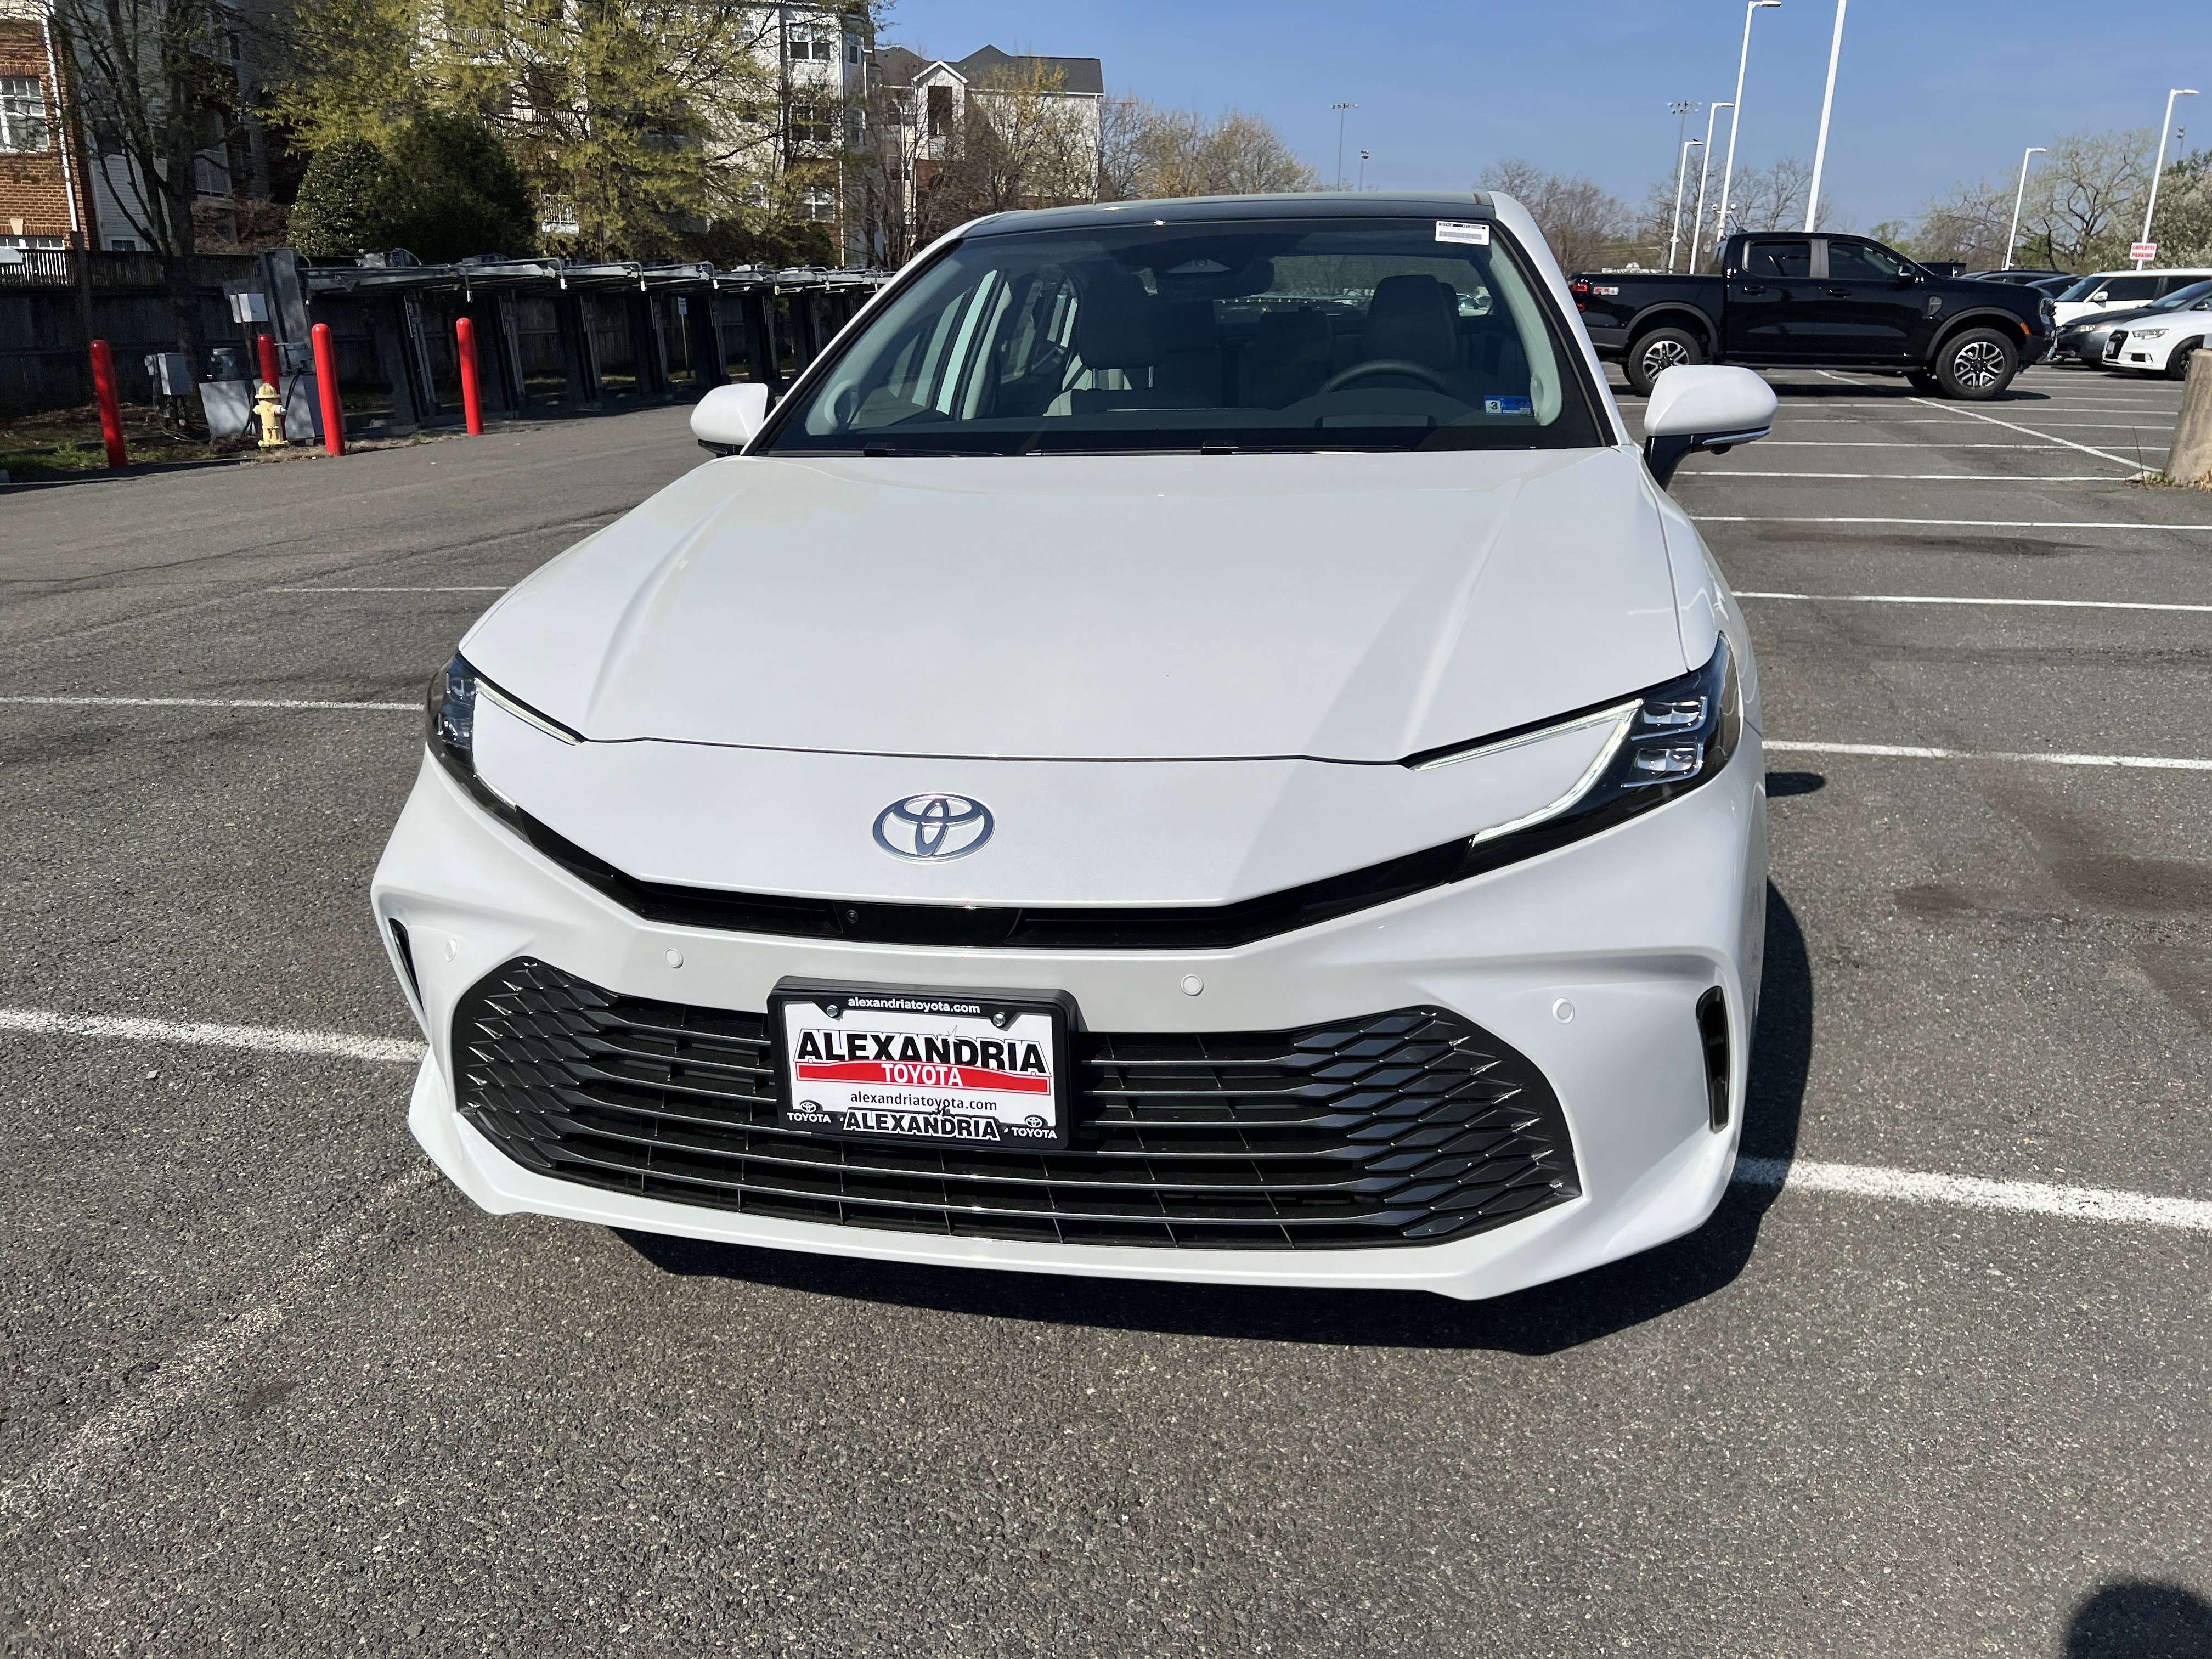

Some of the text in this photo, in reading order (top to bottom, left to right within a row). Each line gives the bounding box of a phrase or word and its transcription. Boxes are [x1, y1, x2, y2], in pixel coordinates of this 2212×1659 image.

[1491, 402, 1498, 410] 3
[848, 996, 980, 1013] alexandriatoyota.com
[796, 1030, 1048, 1074] ALEXANDRIA
[881, 1063, 963, 1086] TOYOTA
[850, 1091, 997, 1111] alexandriatoyota.com
[787, 1109, 1058, 1141] TOYOTA ALEXANDRIA TOYOTA
